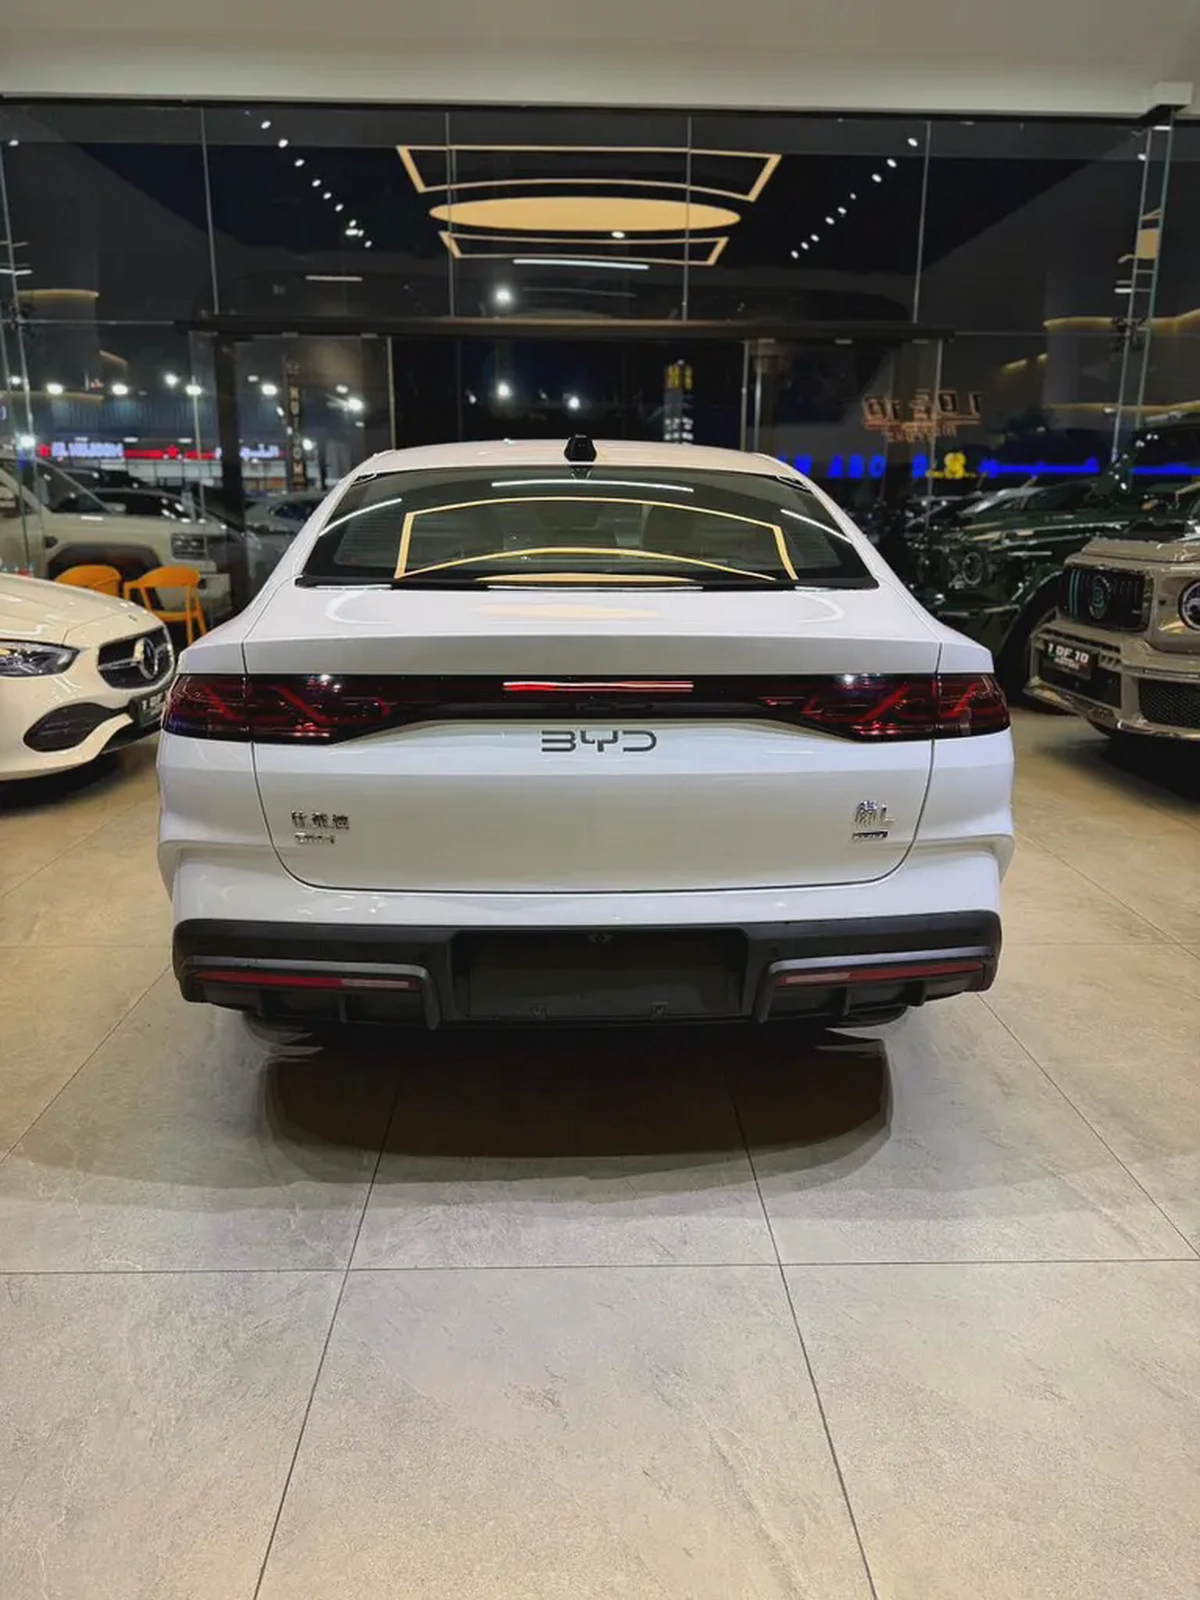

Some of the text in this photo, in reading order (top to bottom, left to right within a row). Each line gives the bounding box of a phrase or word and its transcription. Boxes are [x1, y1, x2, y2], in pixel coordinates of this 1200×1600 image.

[1048, 643, 1054, 654] 1
[1055, 645, 1073, 657] OF
[1075, 650, 1090, 663] 10
[541, 730, 657, 752] BYD
